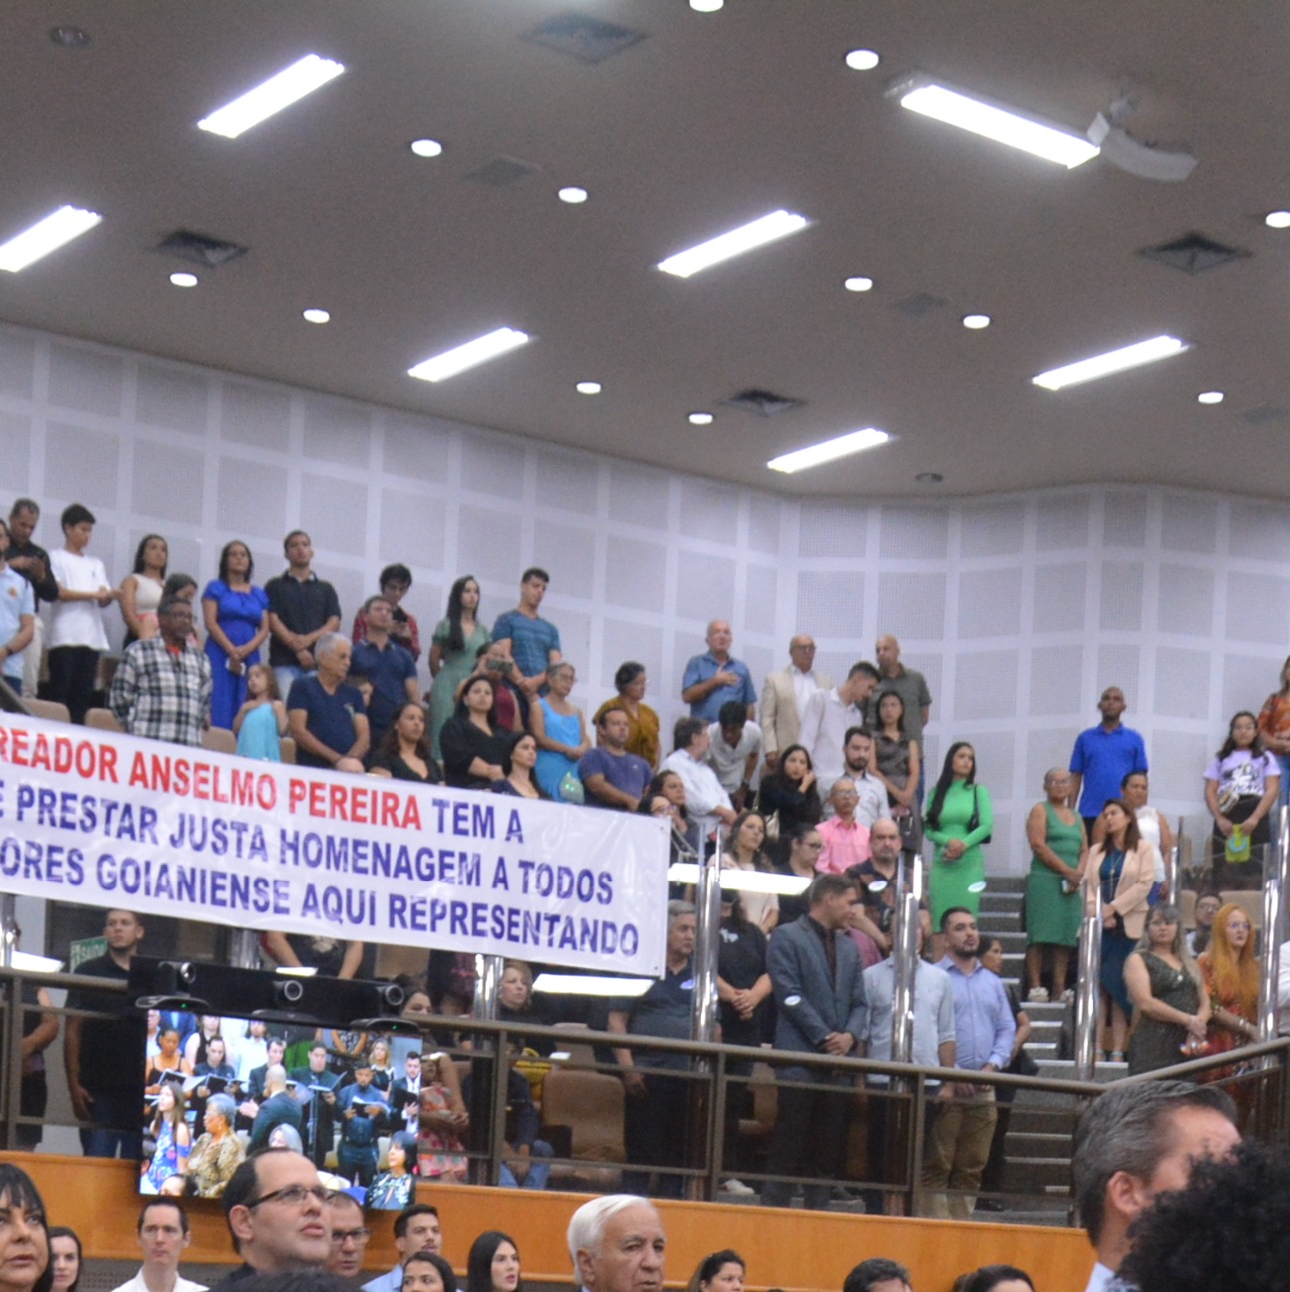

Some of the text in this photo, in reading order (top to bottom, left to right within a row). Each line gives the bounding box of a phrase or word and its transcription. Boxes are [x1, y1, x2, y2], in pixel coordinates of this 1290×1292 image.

[16, 784, 158, 845] PRESTAR
[169, 812, 268, 862] JUSTA
[280, 828, 481, 887] HOMENAGEM
[491, 856, 509, 891] A
[518, 859, 613, 905] TODOS
[128, 751, 277, 811] ANSELMO
[289, 778, 422, 831] PEREIRA
[432, 798, 495, 839] TEM
[505, 809, 524, 844] A
[96, 854, 290, 915] GOIANIENSE
[301, 884, 376, 926] AQUI
[389, 893, 639, 956] REPRESENTANDO
